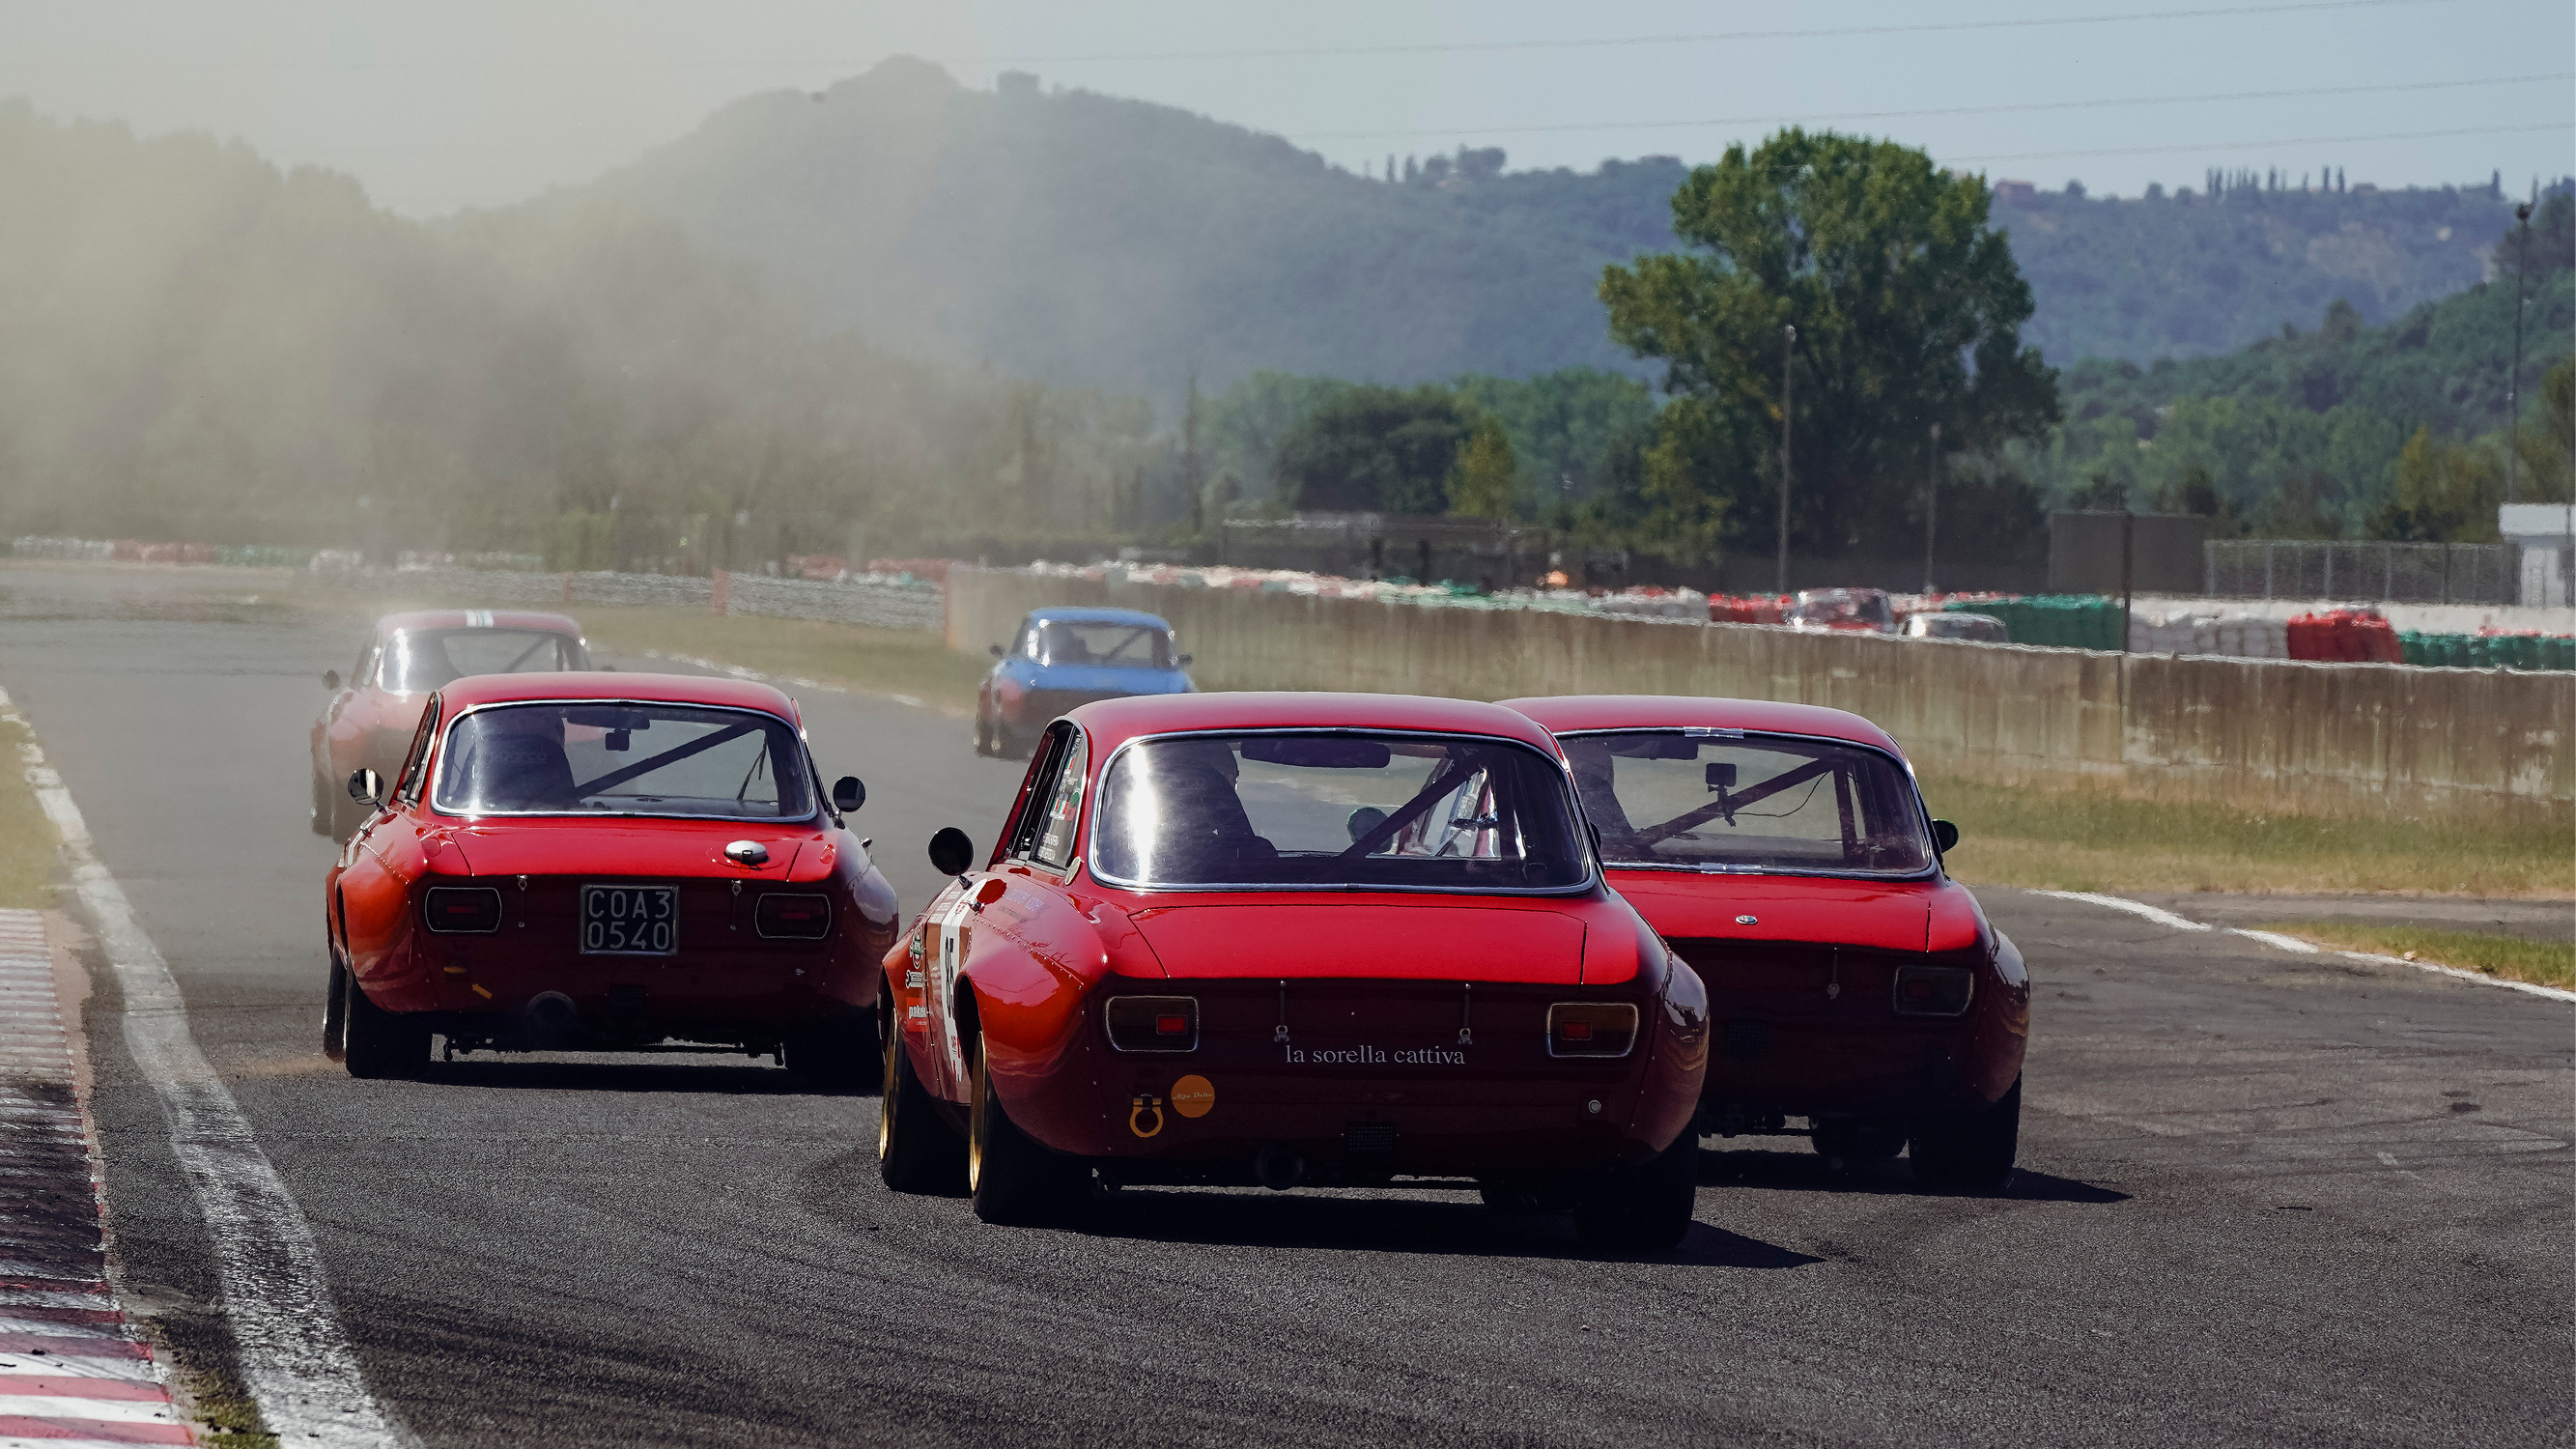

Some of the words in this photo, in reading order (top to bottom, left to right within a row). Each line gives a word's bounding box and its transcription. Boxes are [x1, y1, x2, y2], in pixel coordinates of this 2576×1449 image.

[588, 890, 671, 920] COA3
[587, 921, 670, 951] 0540
[1285, 1044, 1305, 1064] la
[1313, 1044, 1387, 1064] sorella
[1394, 1044, 1466, 1065] cattiva
